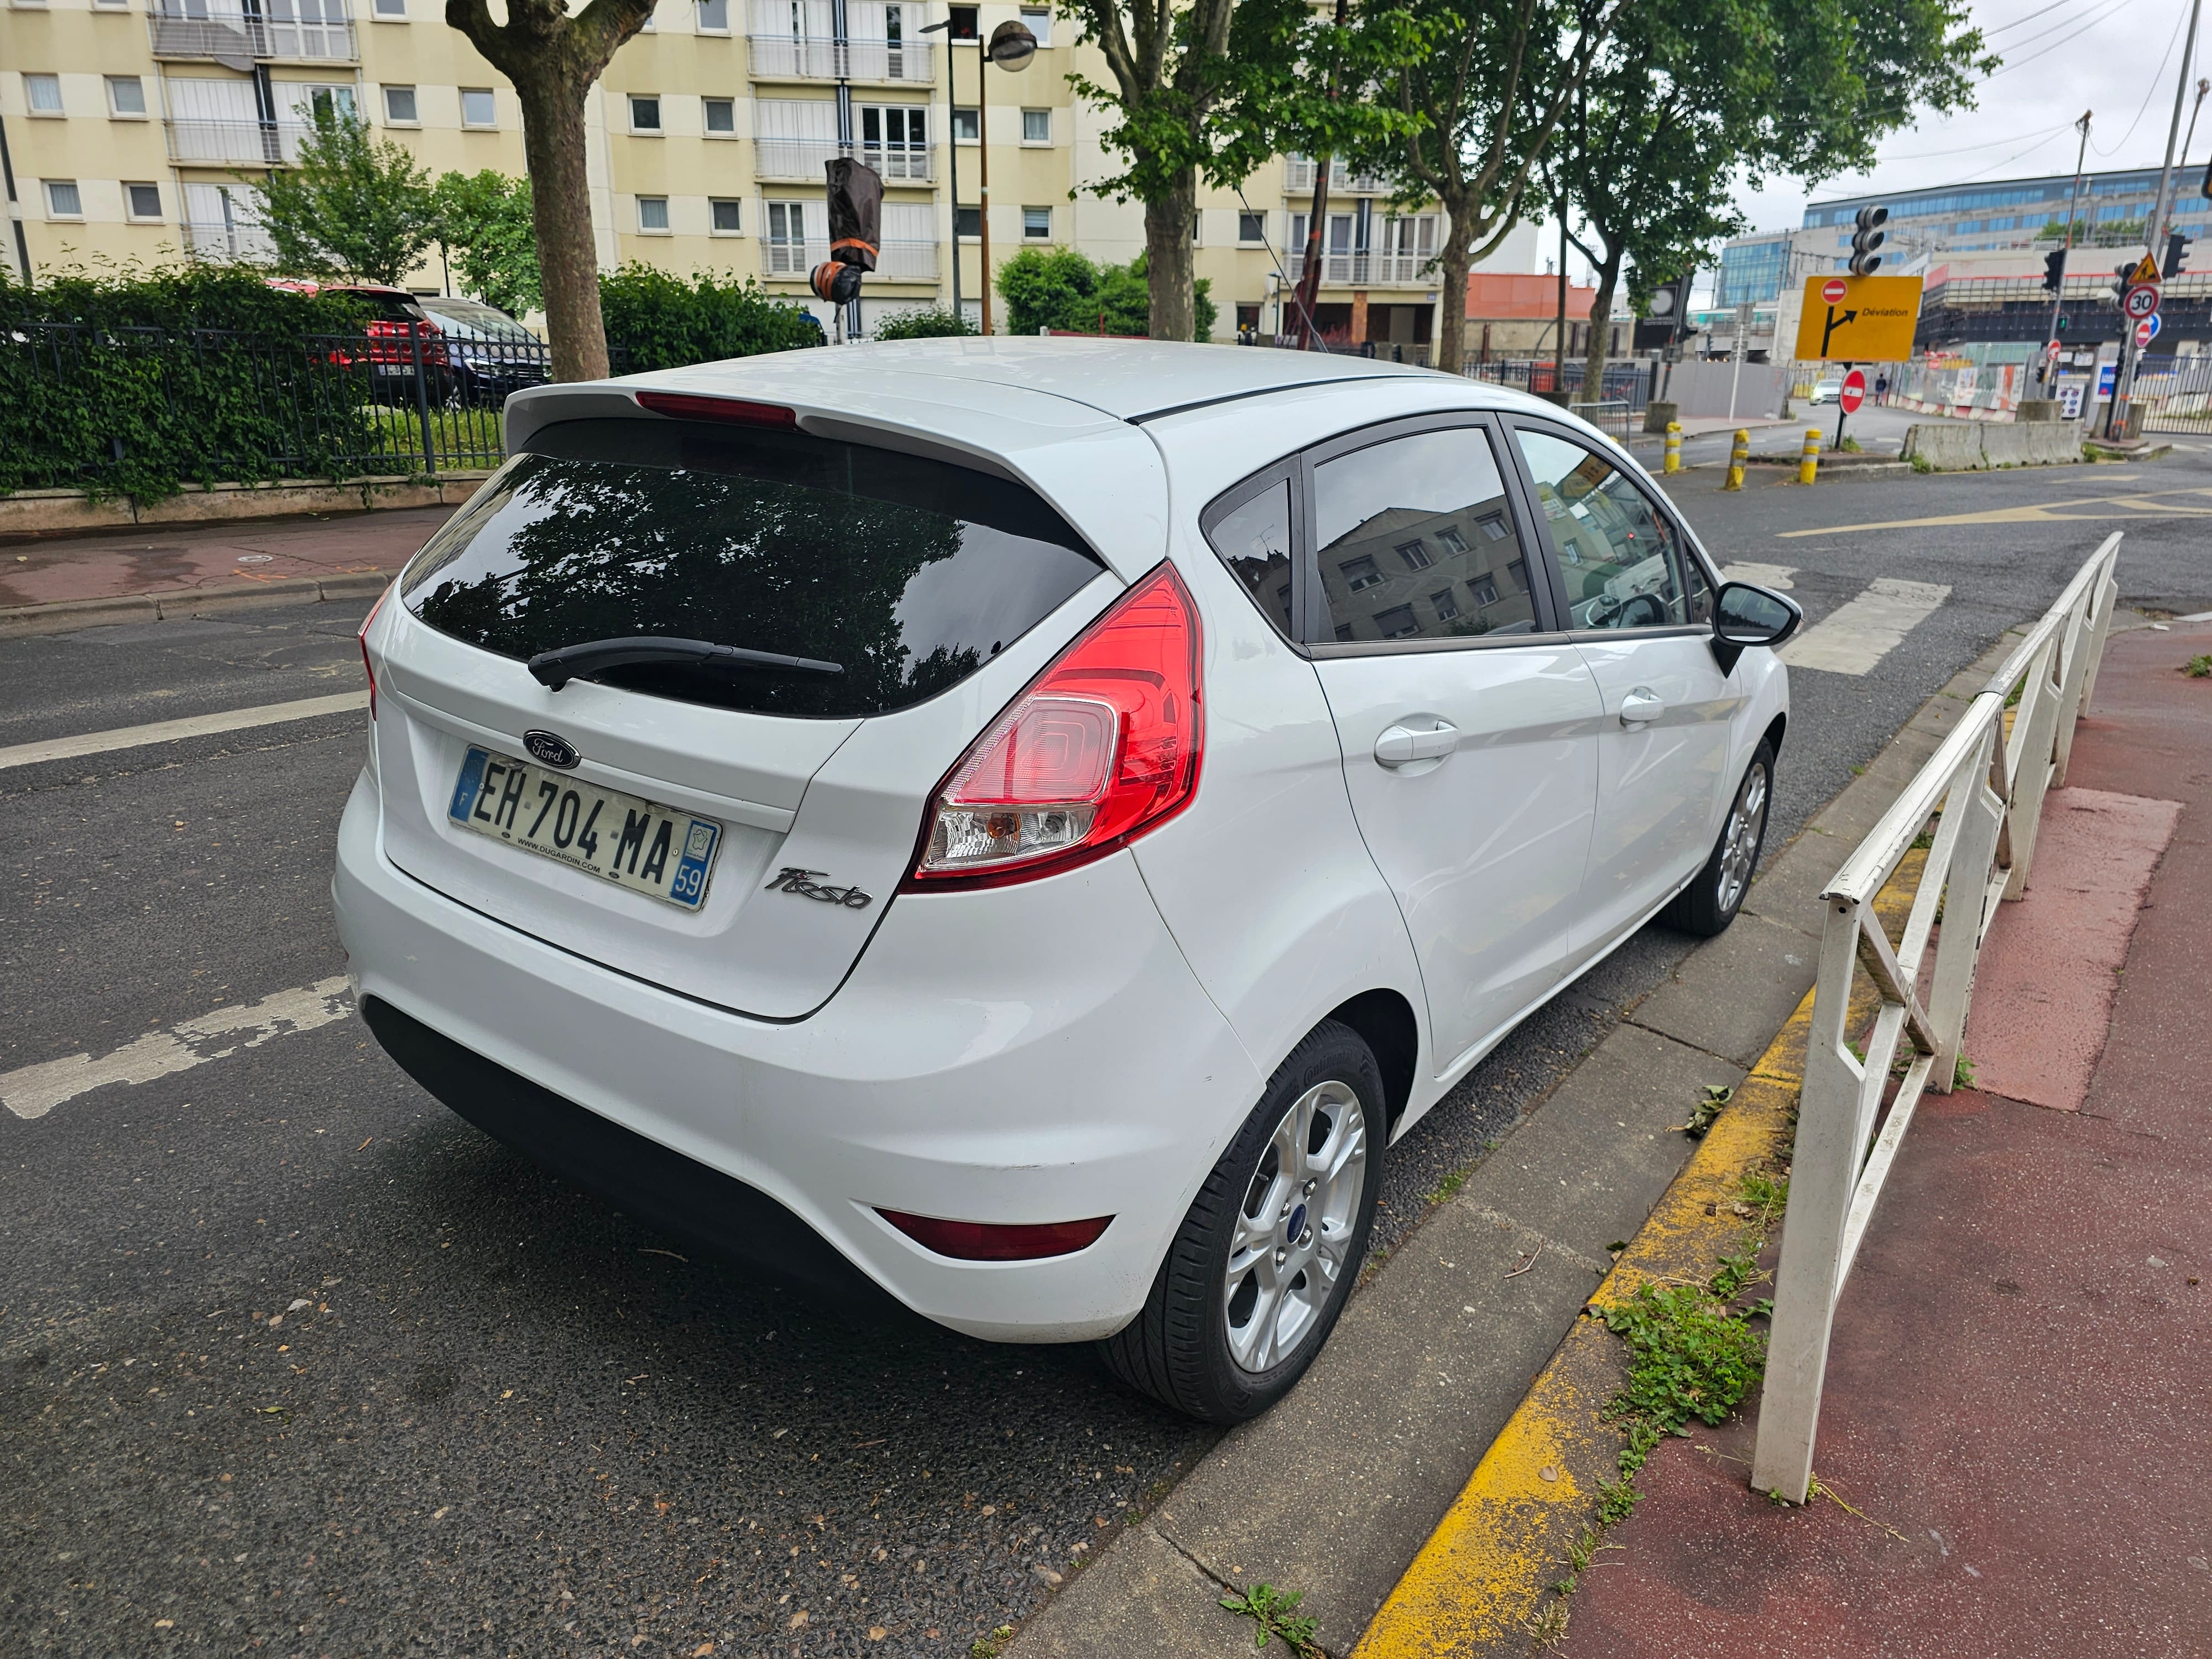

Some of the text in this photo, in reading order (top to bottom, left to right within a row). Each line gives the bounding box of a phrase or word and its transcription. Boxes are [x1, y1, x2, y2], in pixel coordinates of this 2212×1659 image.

[1862, 306, 1908, 317] Déviation
[2131, 295, 2153, 310] 30
[533, 738, 563, 763] Ford
[459, 792, 468, 806] F
[518, 837, 601, 874] WWW.DUGARDIN.COM
[675, 864, 702, 896] 59
[764, 867, 874, 910] Fiesta
